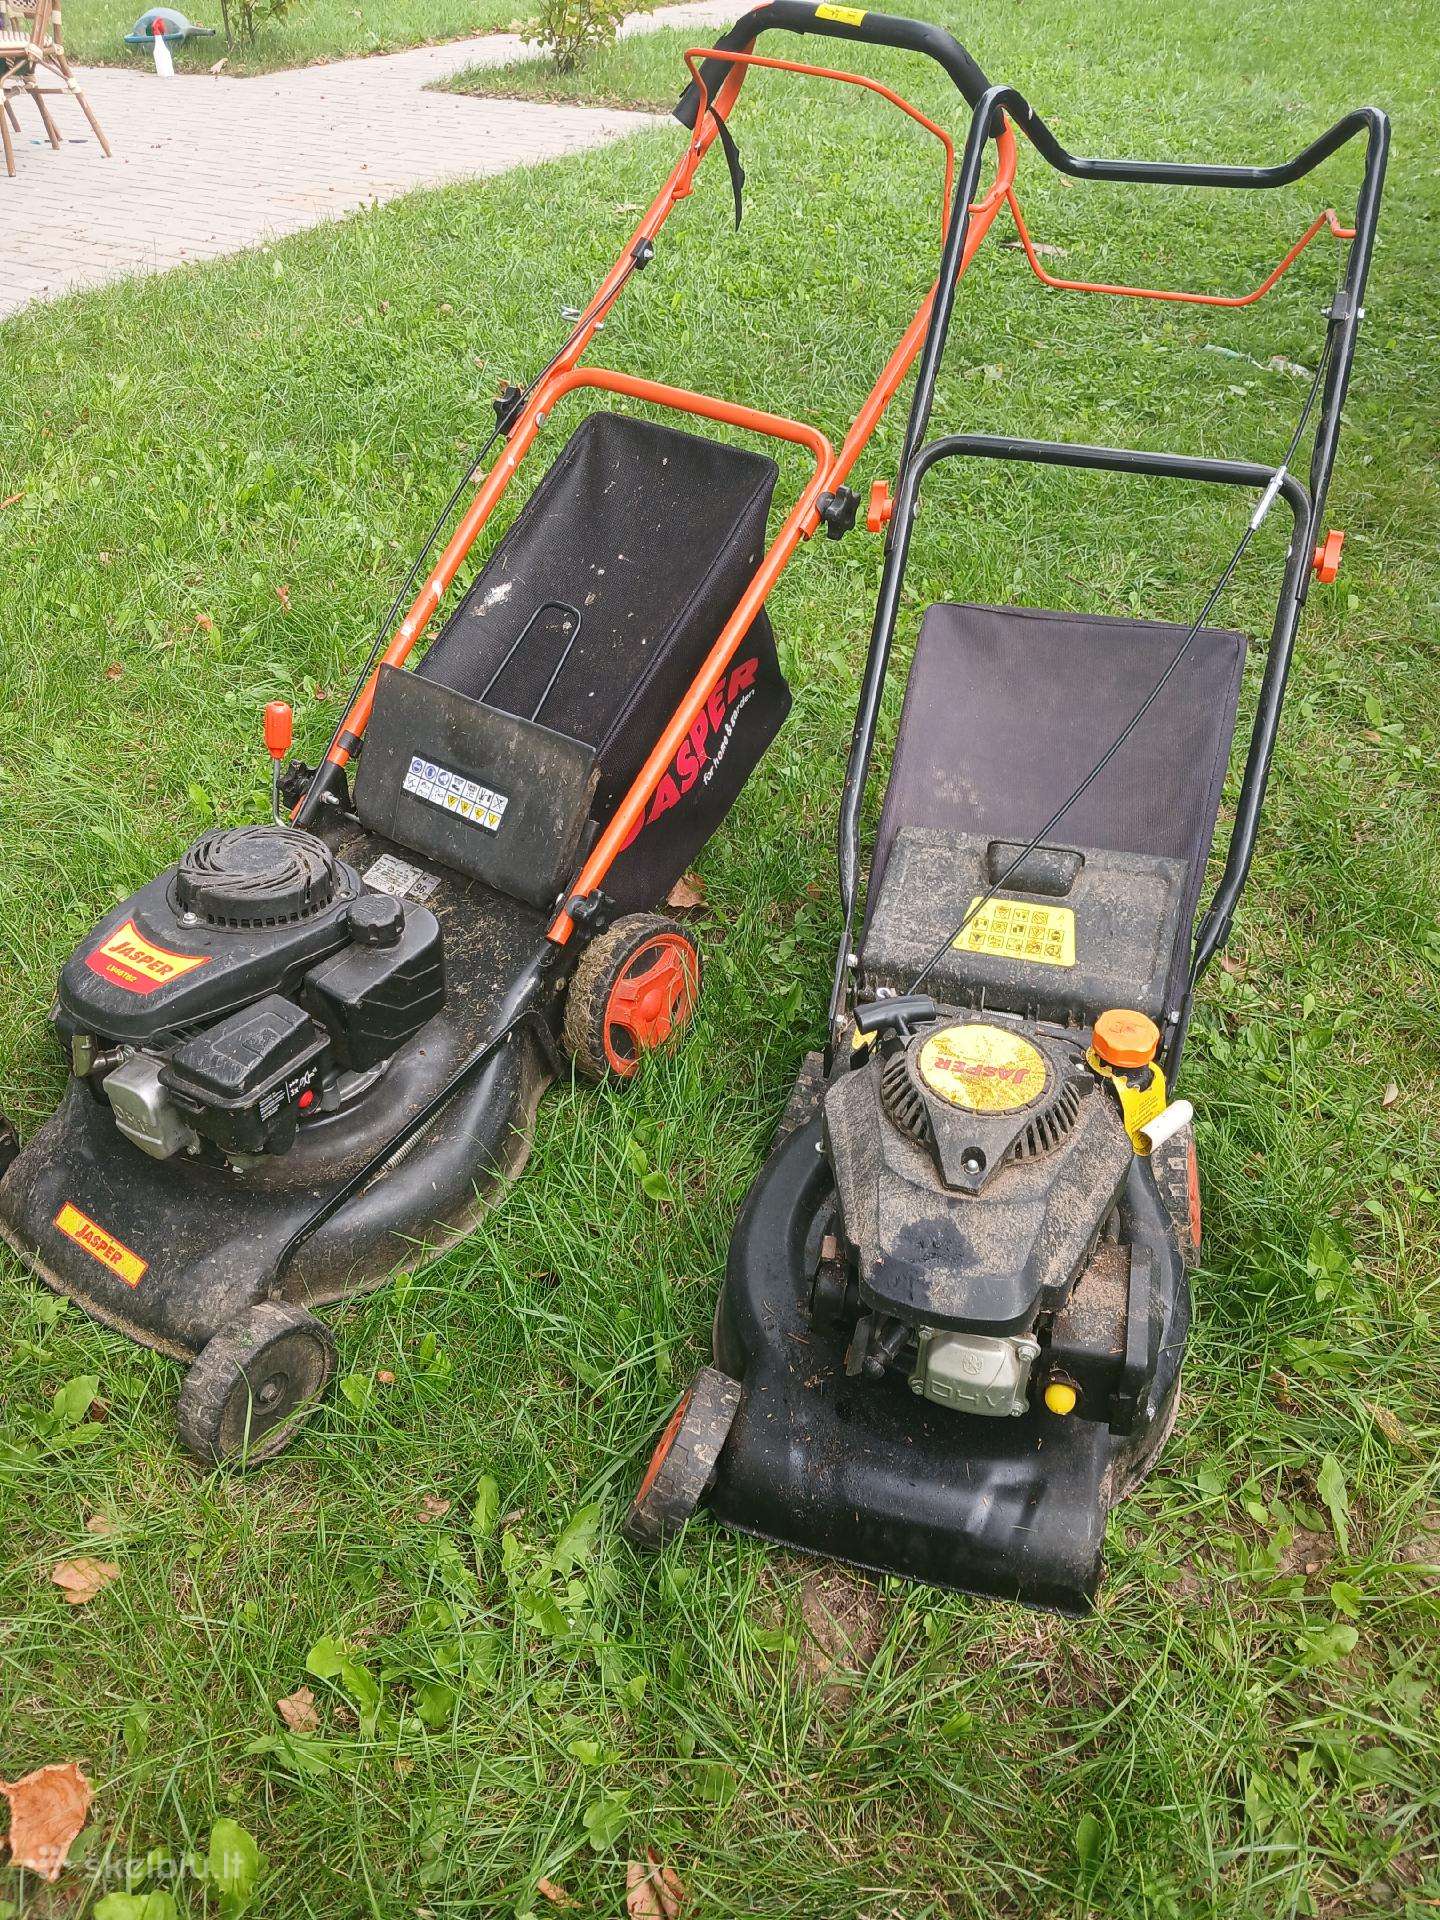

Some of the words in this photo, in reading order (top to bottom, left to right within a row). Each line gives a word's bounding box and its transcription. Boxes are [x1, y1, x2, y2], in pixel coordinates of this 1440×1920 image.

[703, 765, 714, 786] for
[713, 735, 729, 769] home
[724, 723, 733, 737] &
[730, 689, 755, 728] garden
[108, 941, 174, 976] JASPER
[934, 1055, 1031, 1085] JASPER
[75, 1223, 123, 1265] JASPER
